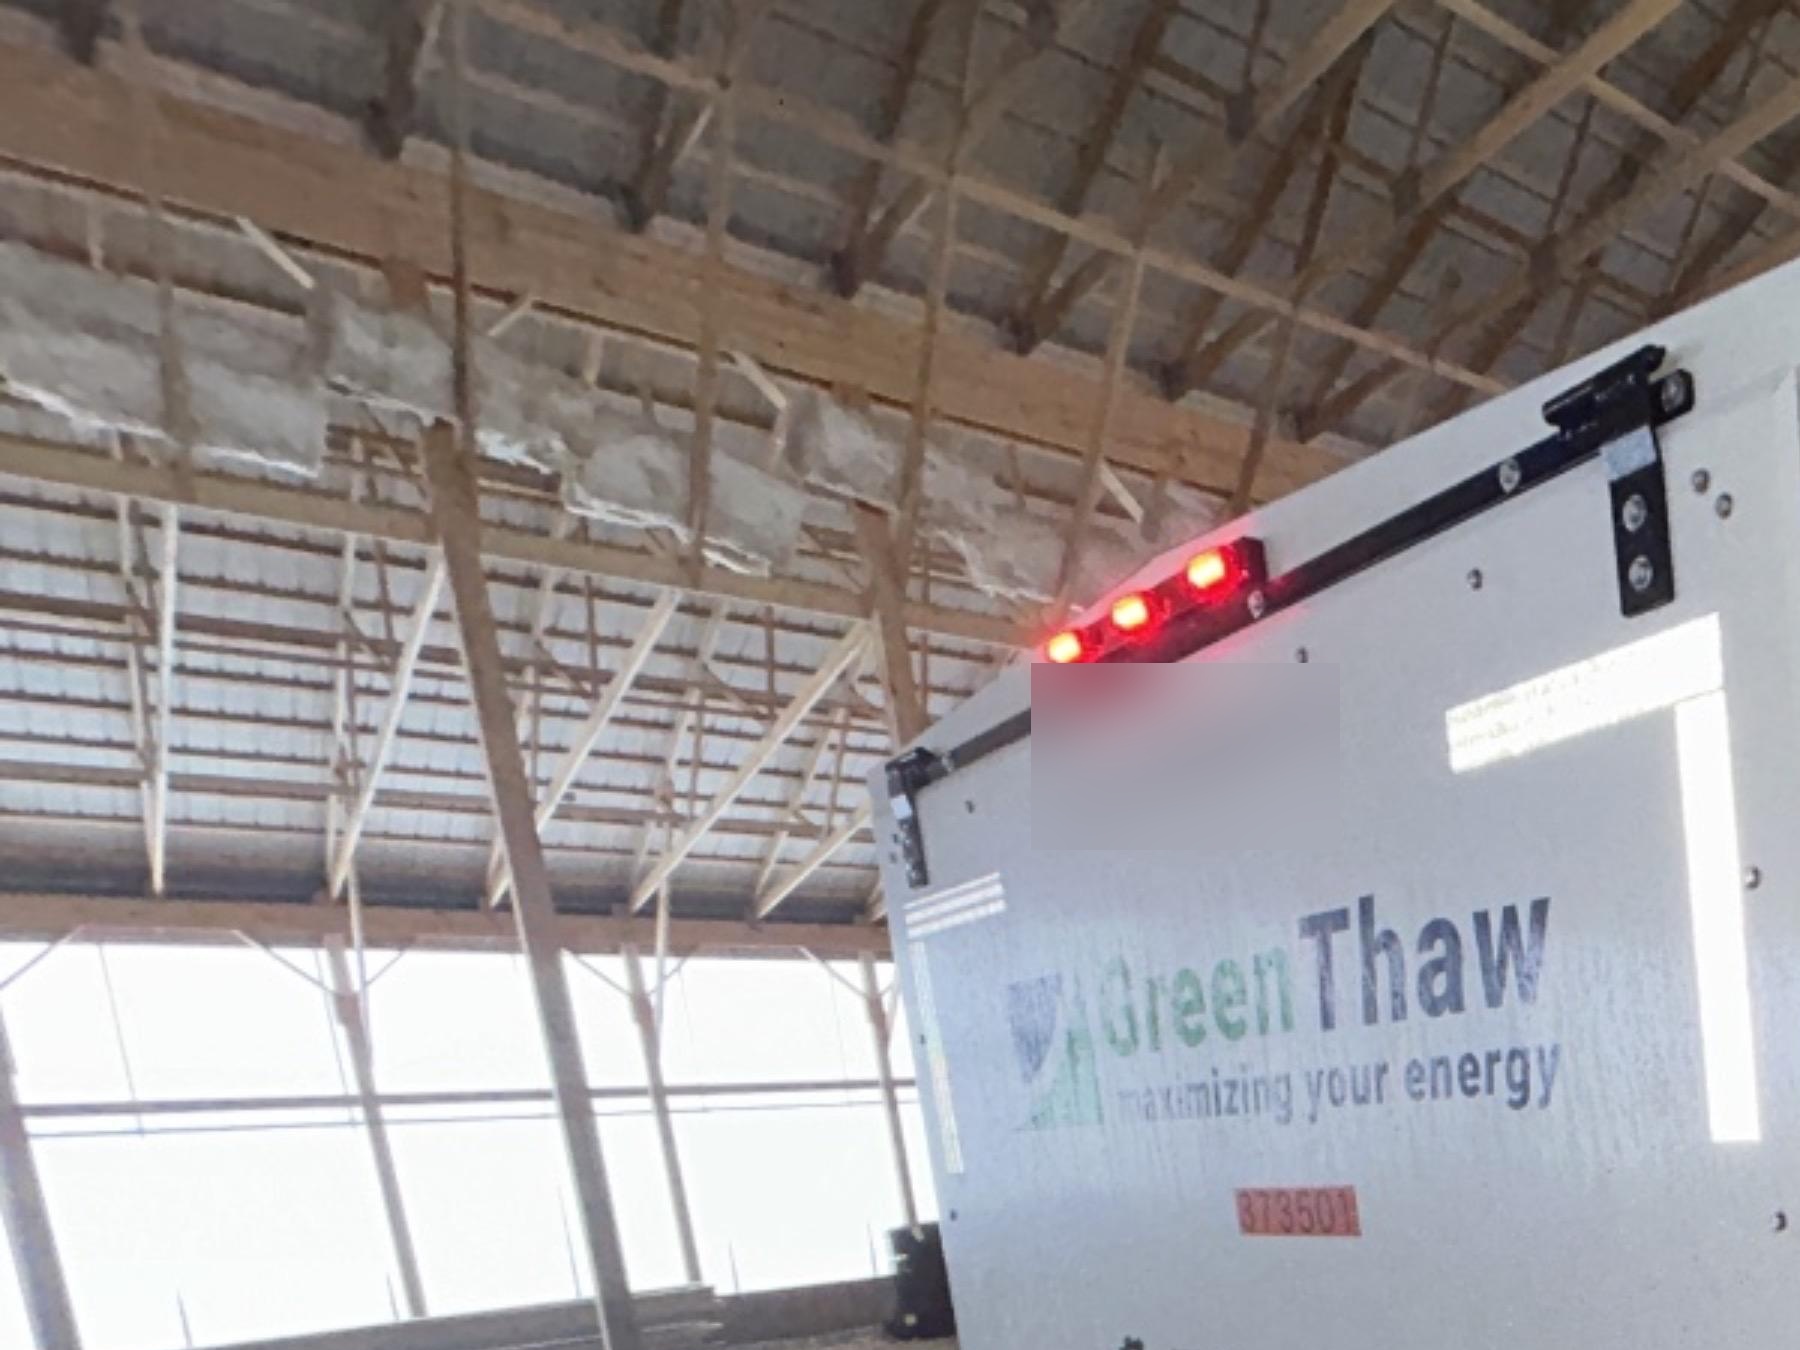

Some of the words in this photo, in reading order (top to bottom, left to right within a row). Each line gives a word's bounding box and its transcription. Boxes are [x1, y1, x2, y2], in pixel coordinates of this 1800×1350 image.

[1101, 894, 1552, 1057] GreenThaw
[1115, 1066, 1292, 1126] maximizing
[1307, 1058, 1390, 1123] your
[1404, 1043, 1561, 1110] energy
